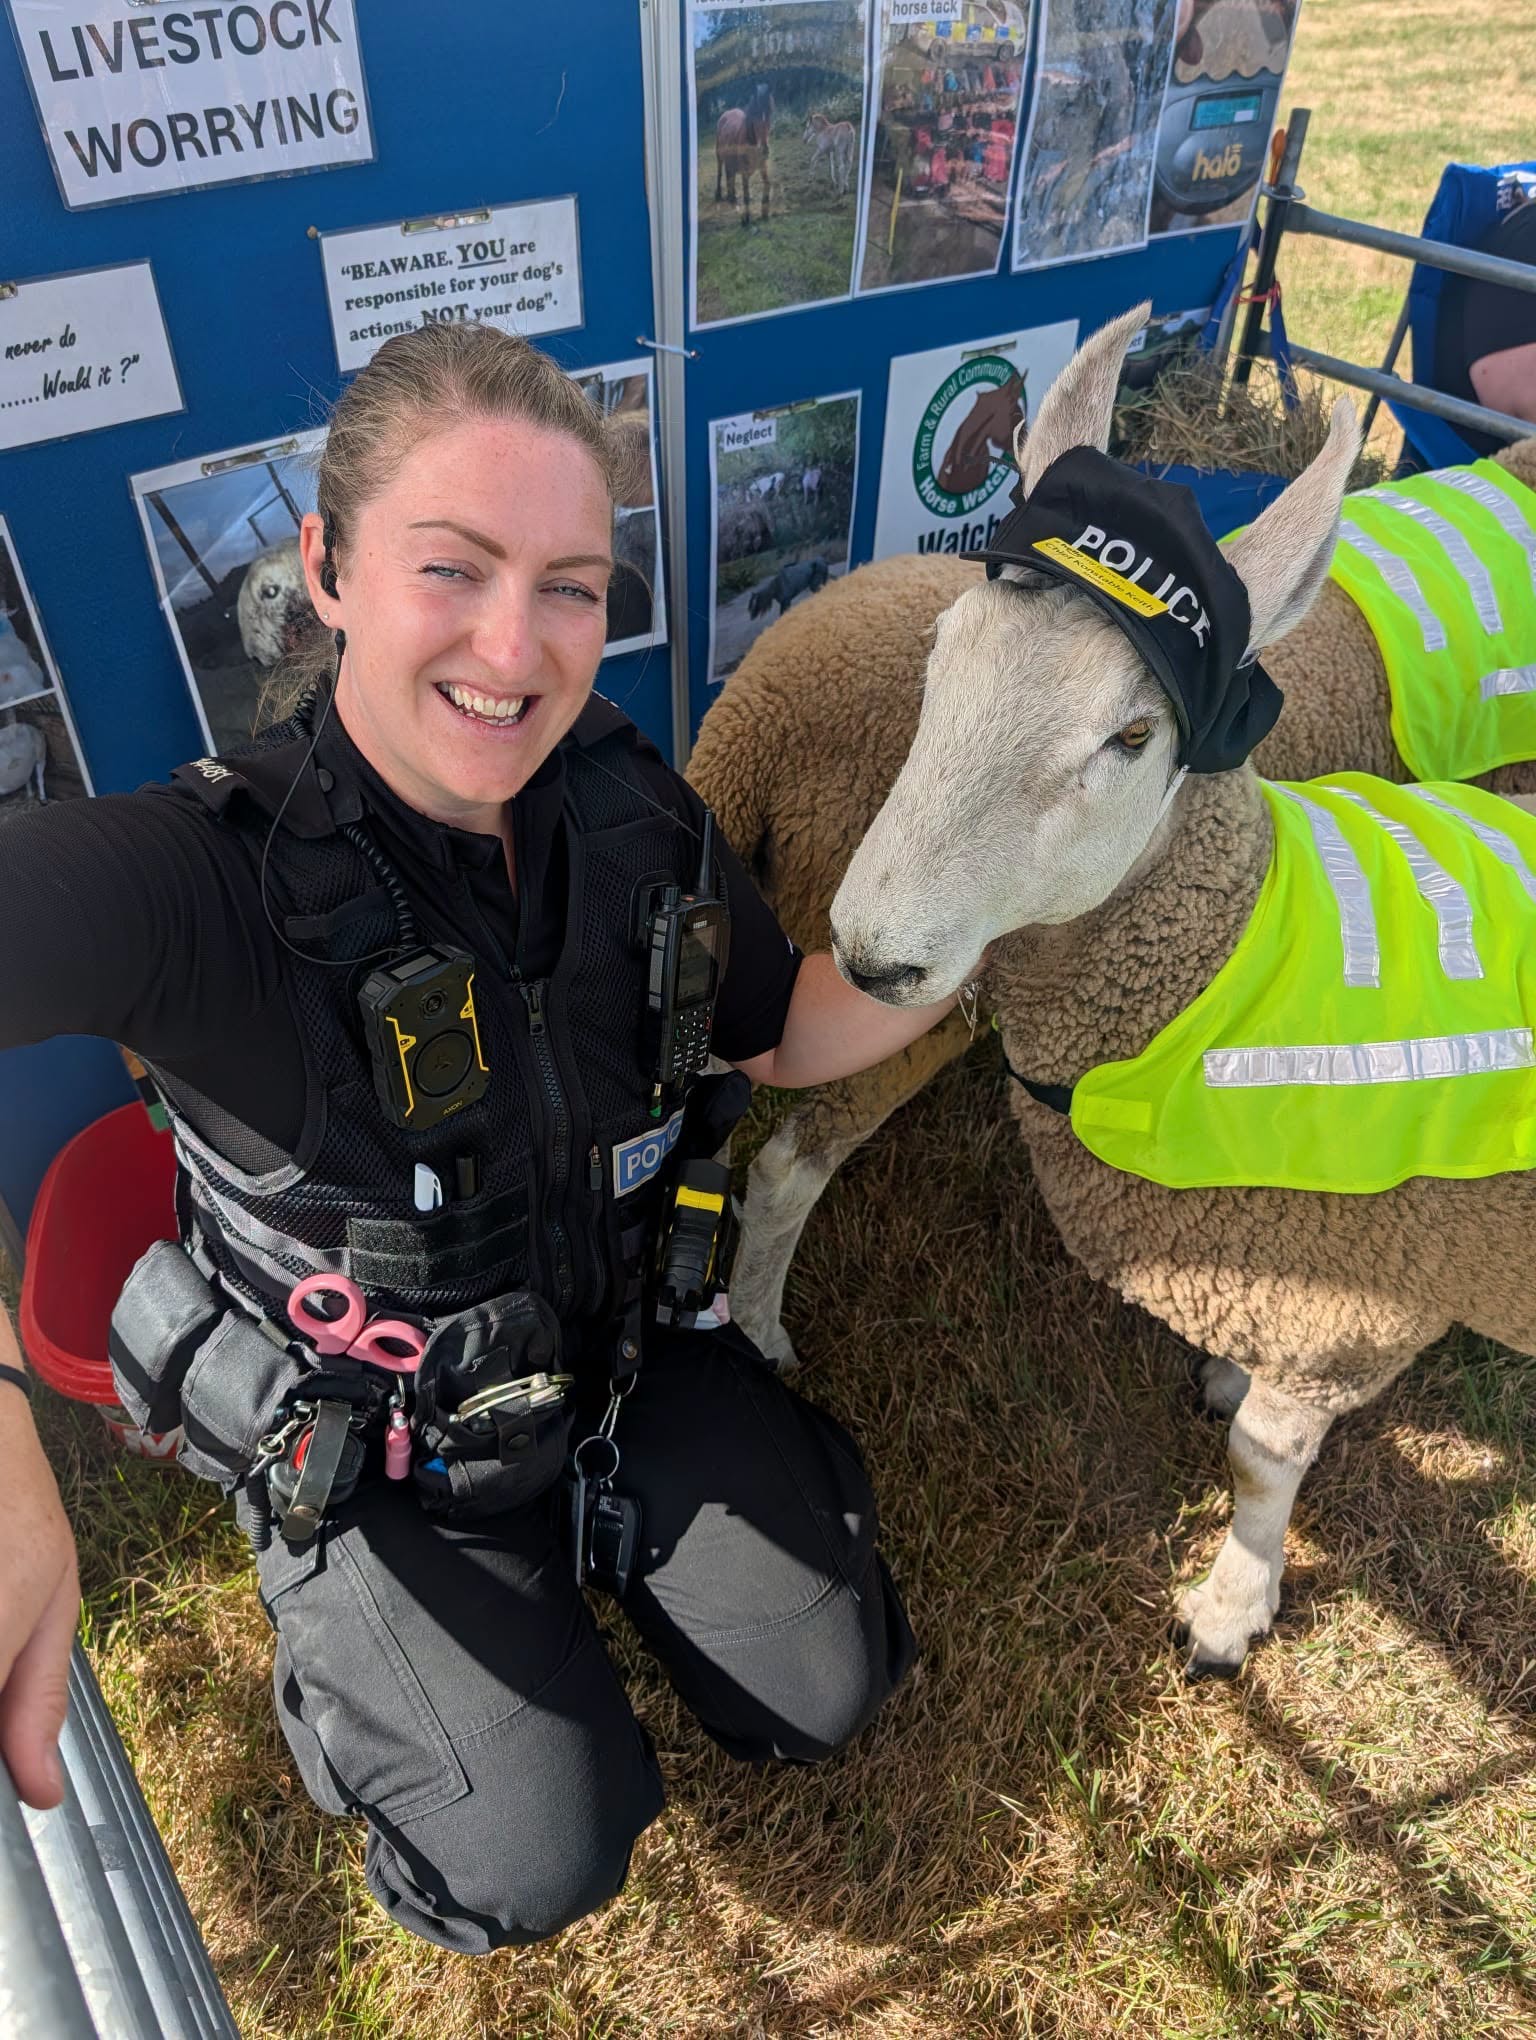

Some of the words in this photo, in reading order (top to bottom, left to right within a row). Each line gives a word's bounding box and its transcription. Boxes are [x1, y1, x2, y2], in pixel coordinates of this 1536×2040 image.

[893, 0, 928, 16] horse
[930, 0, 958, 14] tack
[38, 0, 342, 82] LIVESTOCK
[64, 88, 359, 178] WORRYING
[456, 238, 507, 267] YOU
[510, 241, 536, 256] are
[345, 281, 446, 311] responsible
[449, 278, 476, 293] for
[479, 271, 519, 292] your
[522, 261, 563, 281] dog's
[421, 303, 469, 326] NOT
[473, 303, 513, 320] your
[5, 337, 52, 360] never
[59, 324, 77, 348] do
[98, 366, 112, 387] it
[930, 378, 959, 417] Rural
[725, 425, 773, 447] Neglect
[924, 418, 937, 430] &
[916, 433, 932, 472] Farm
[919, 475, 958, 514] Horse
[961, 463, 1010, 511] Watch
[627, 1119, 682, 1180] POLIC
